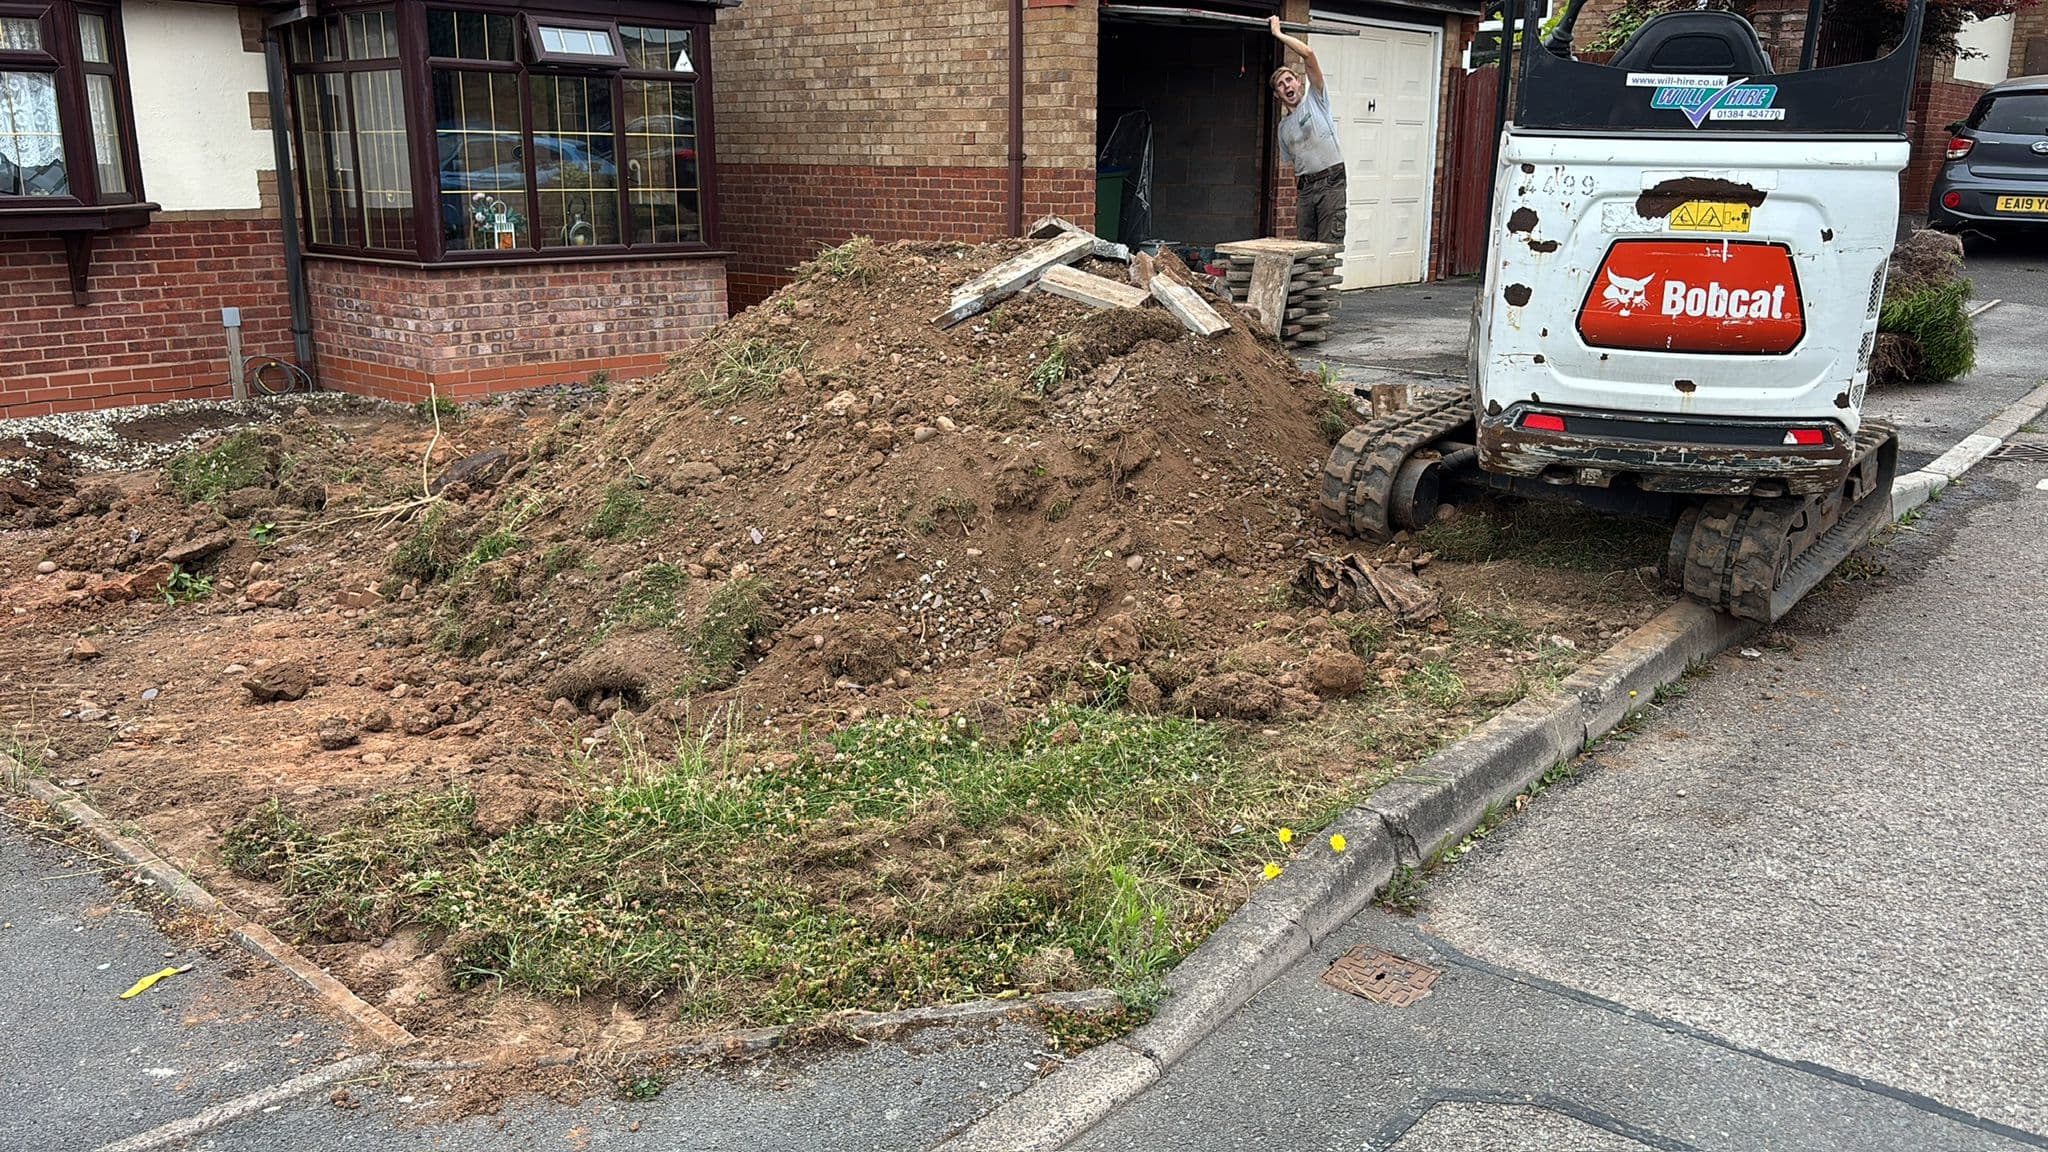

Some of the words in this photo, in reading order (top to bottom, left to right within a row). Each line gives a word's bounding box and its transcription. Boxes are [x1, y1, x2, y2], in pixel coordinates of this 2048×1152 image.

[1631, 75, 1725, 87] www.will-hire.co.uk
[1657, 87, 1705, 106] WILL
[1724, 88, 1768, 106] HIRE
[1717, 109, 1744, 118] 01384
[1746, 110, 1781, 118] 424770
[2004, 198, 2033, 209] EA19
[1661, 280, 1785, 319] Bobcat
